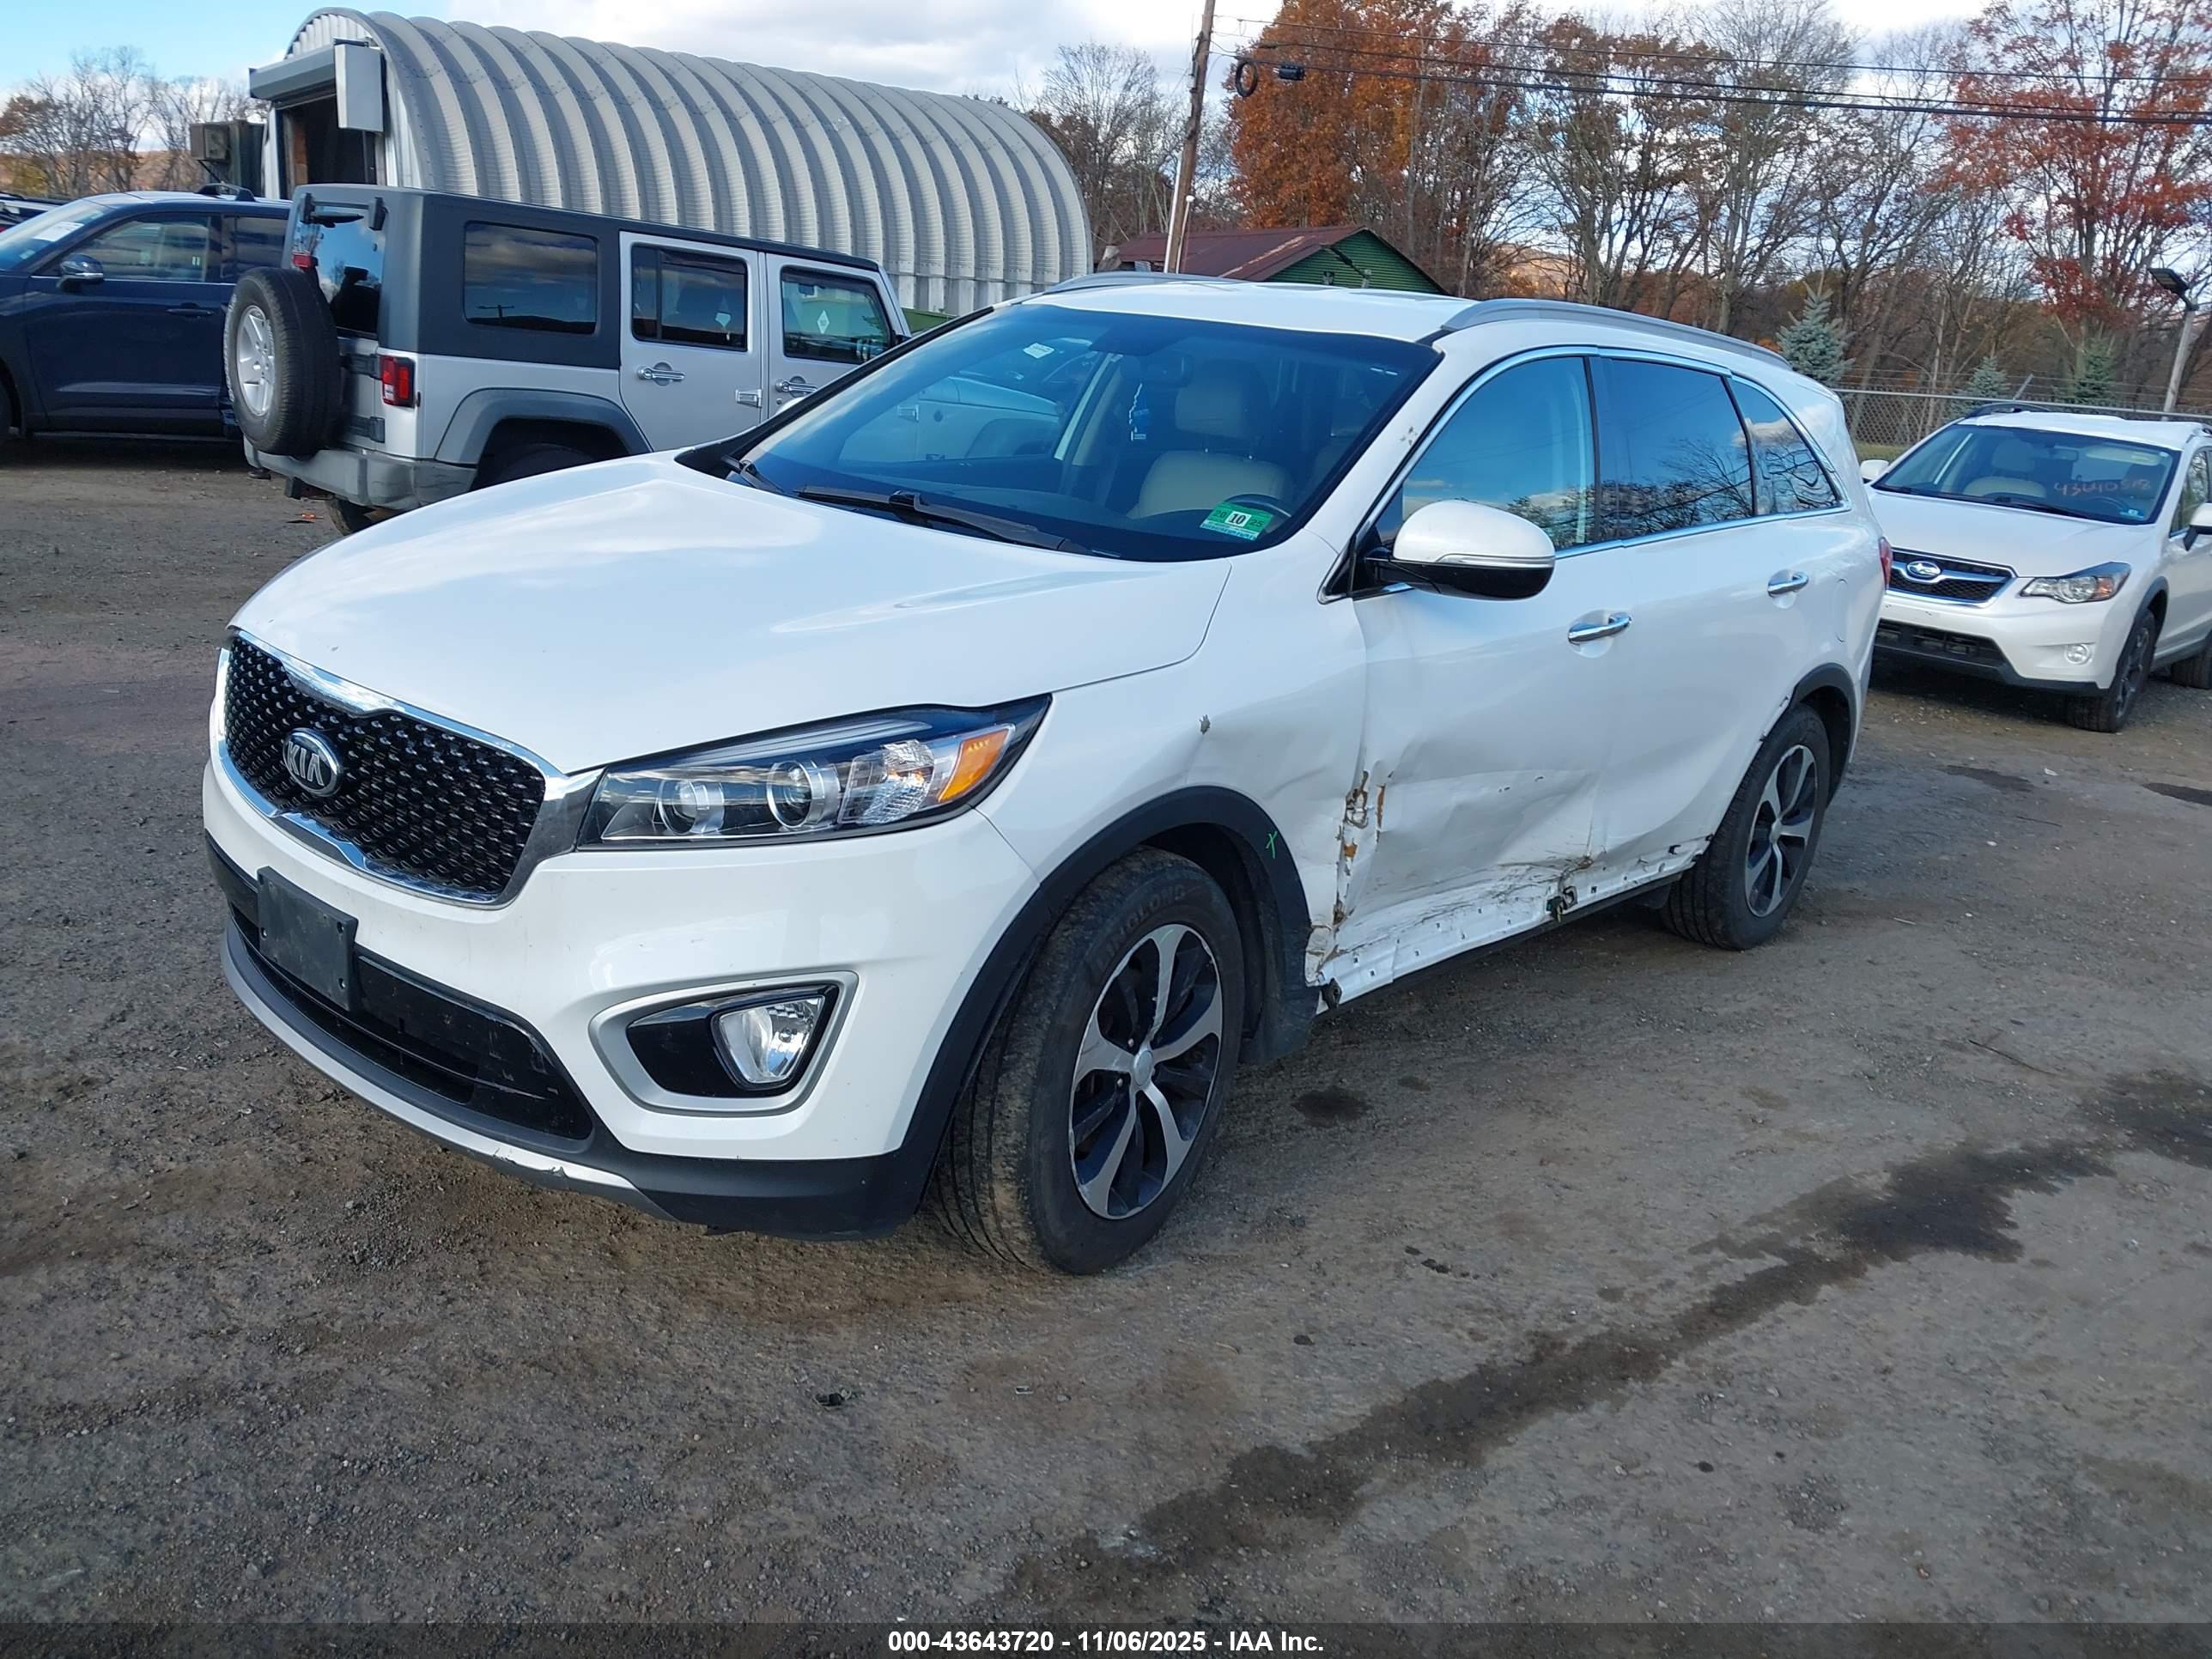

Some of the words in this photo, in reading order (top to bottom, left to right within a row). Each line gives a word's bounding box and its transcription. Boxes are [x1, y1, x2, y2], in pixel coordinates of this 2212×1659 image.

[1229, 513, 1247, 525] 10
[1249, 519, 1264, 527] 25
[287, 740, 325, 787] KIA
